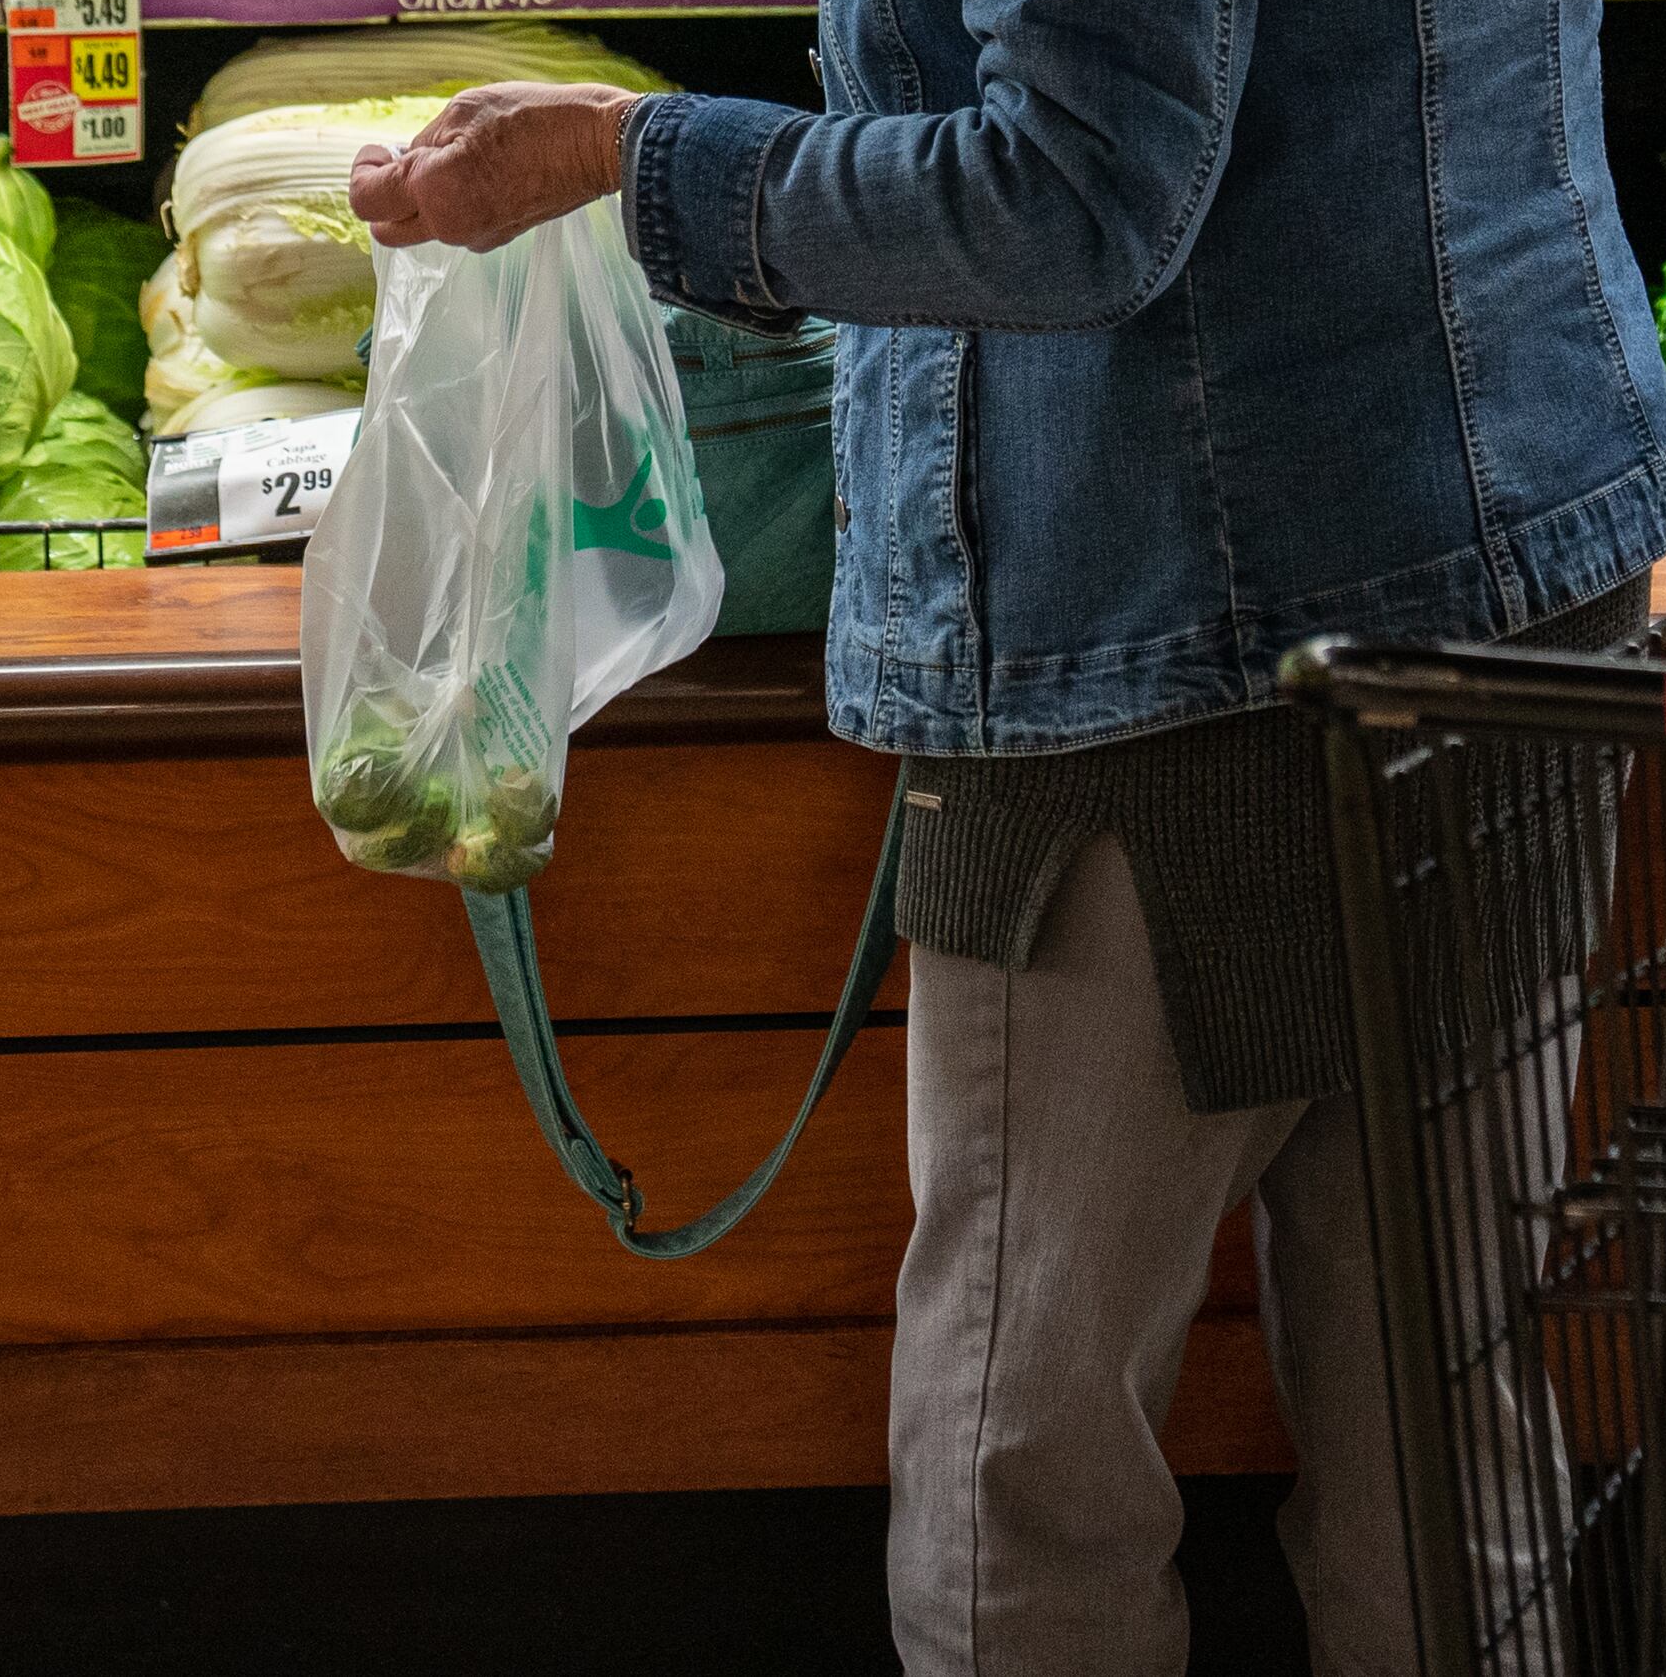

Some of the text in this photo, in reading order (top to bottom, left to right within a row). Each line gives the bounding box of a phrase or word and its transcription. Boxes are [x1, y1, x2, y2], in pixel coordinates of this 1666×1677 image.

[76, 52, 128, 90] $4.49
[267, 452, 327, 468] Cabbage
[283, 444, 316, 454] Napa
[493, 665, 510, 695] danger
[498, 702, 515, 731] plastic
[514, 730, 527, 750] bag
